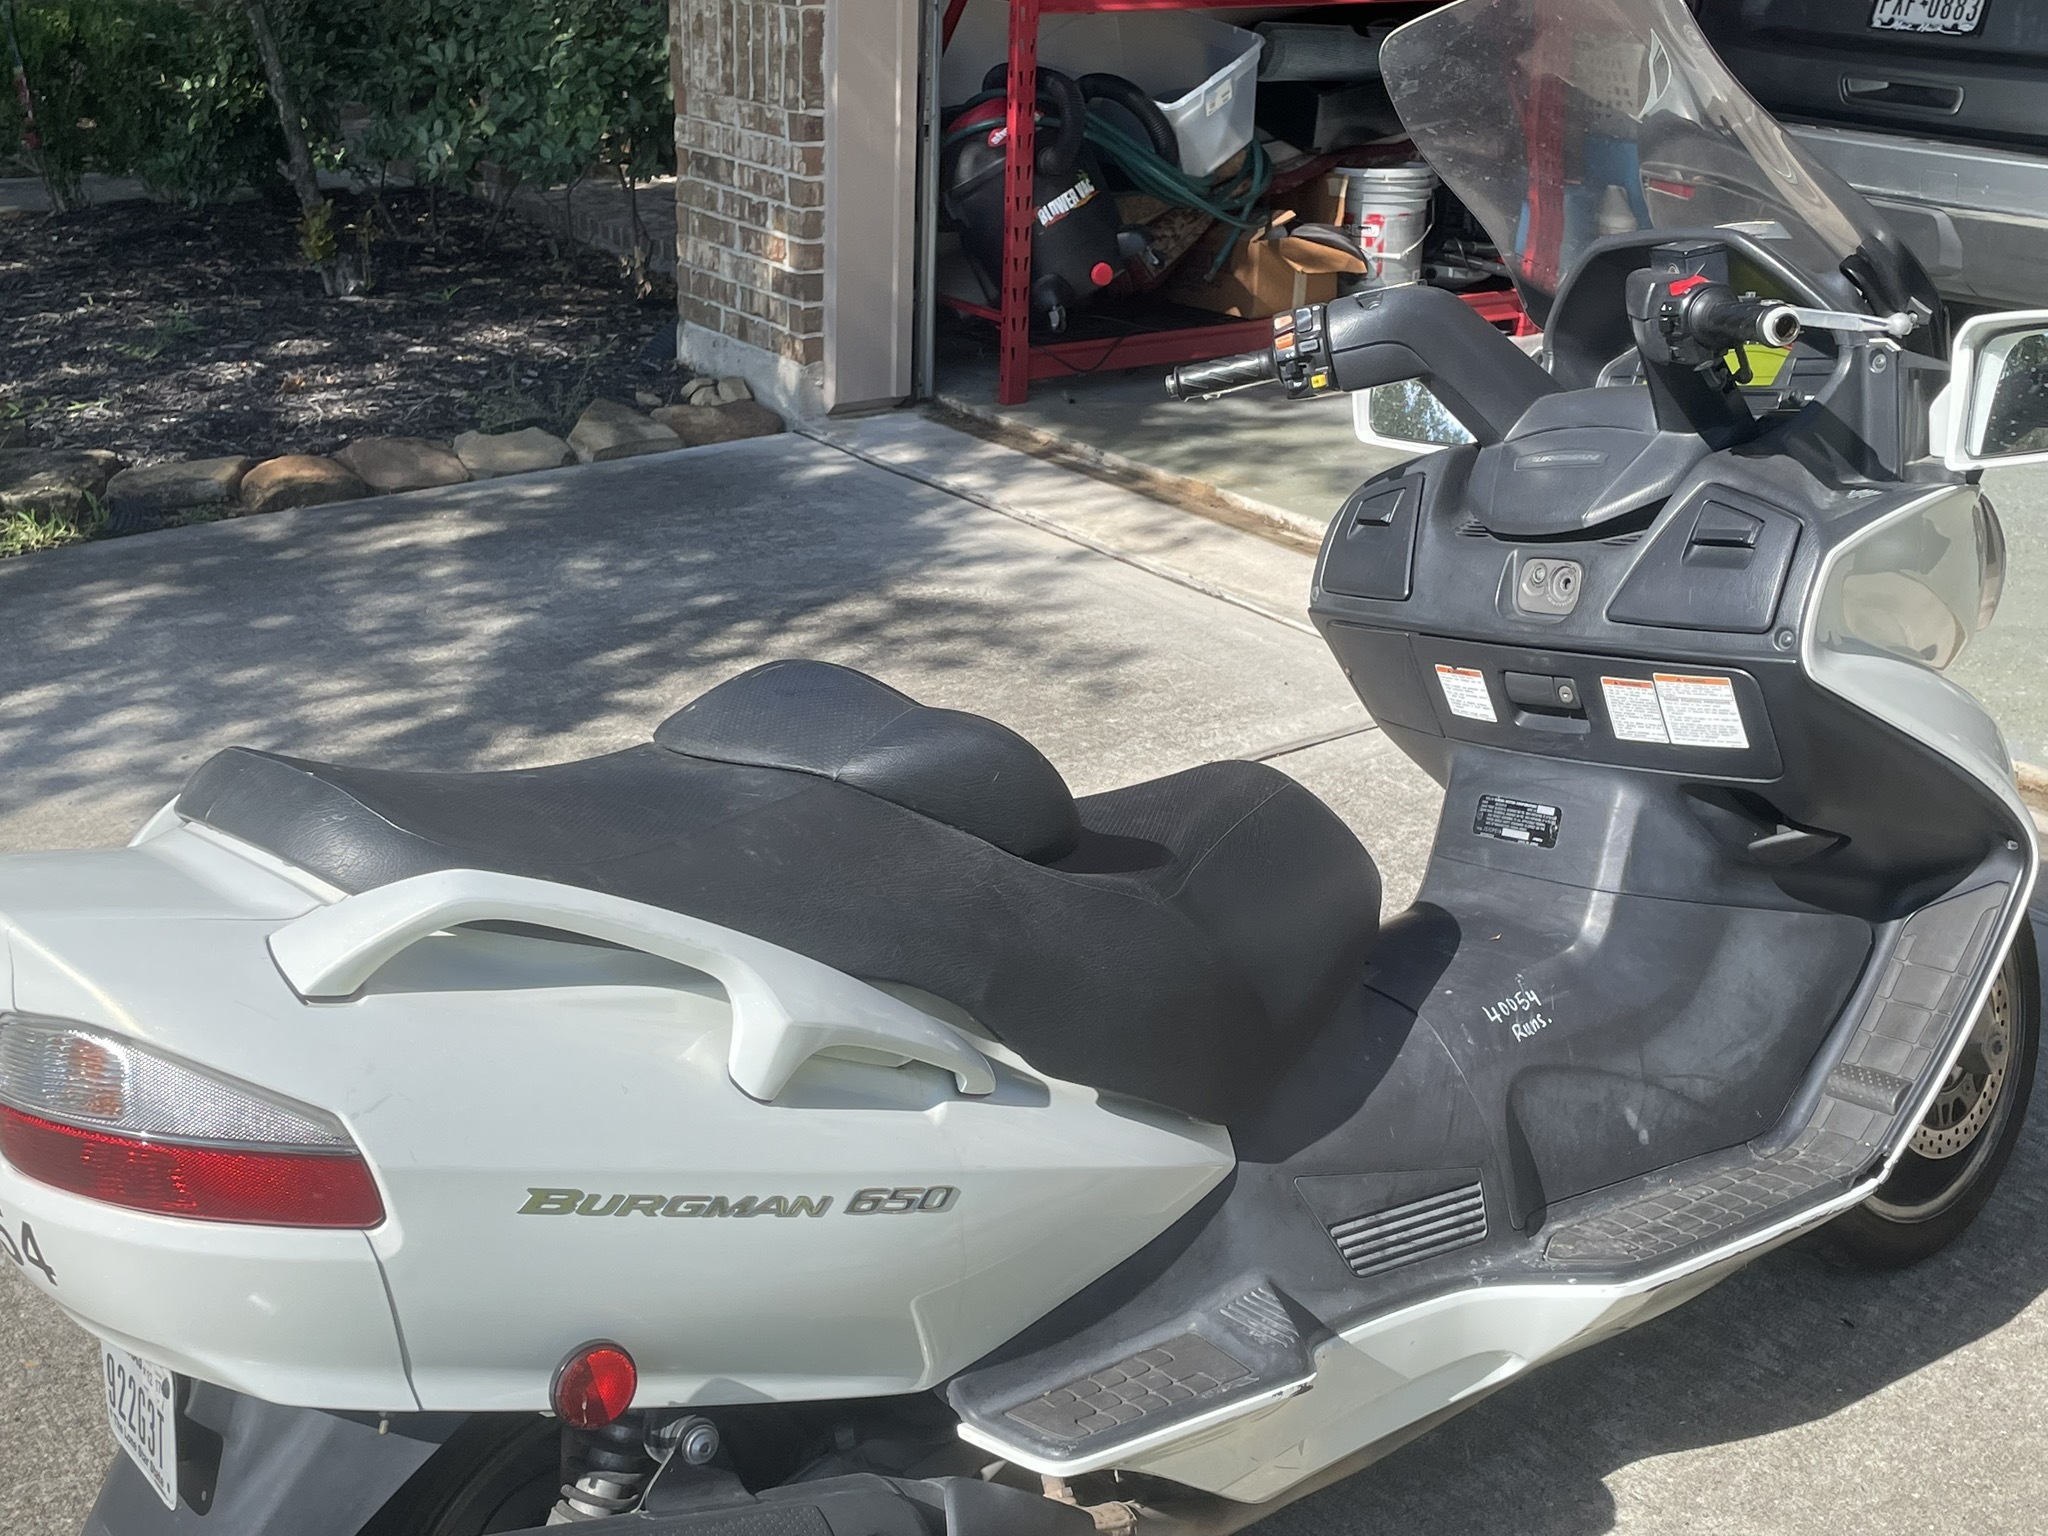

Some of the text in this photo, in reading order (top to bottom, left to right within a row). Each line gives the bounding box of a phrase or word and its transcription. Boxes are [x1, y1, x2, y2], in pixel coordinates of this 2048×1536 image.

[1037, 178, 1096, 226] BLOWER VAC
[1481, 989, 1542, 1024] 40054
[1511, 1013, 1553, 1043] Runs.
[516, 1185, 962, 1218] BURGMAN 650
[106, 1352, 165, 1470] 922G3T
